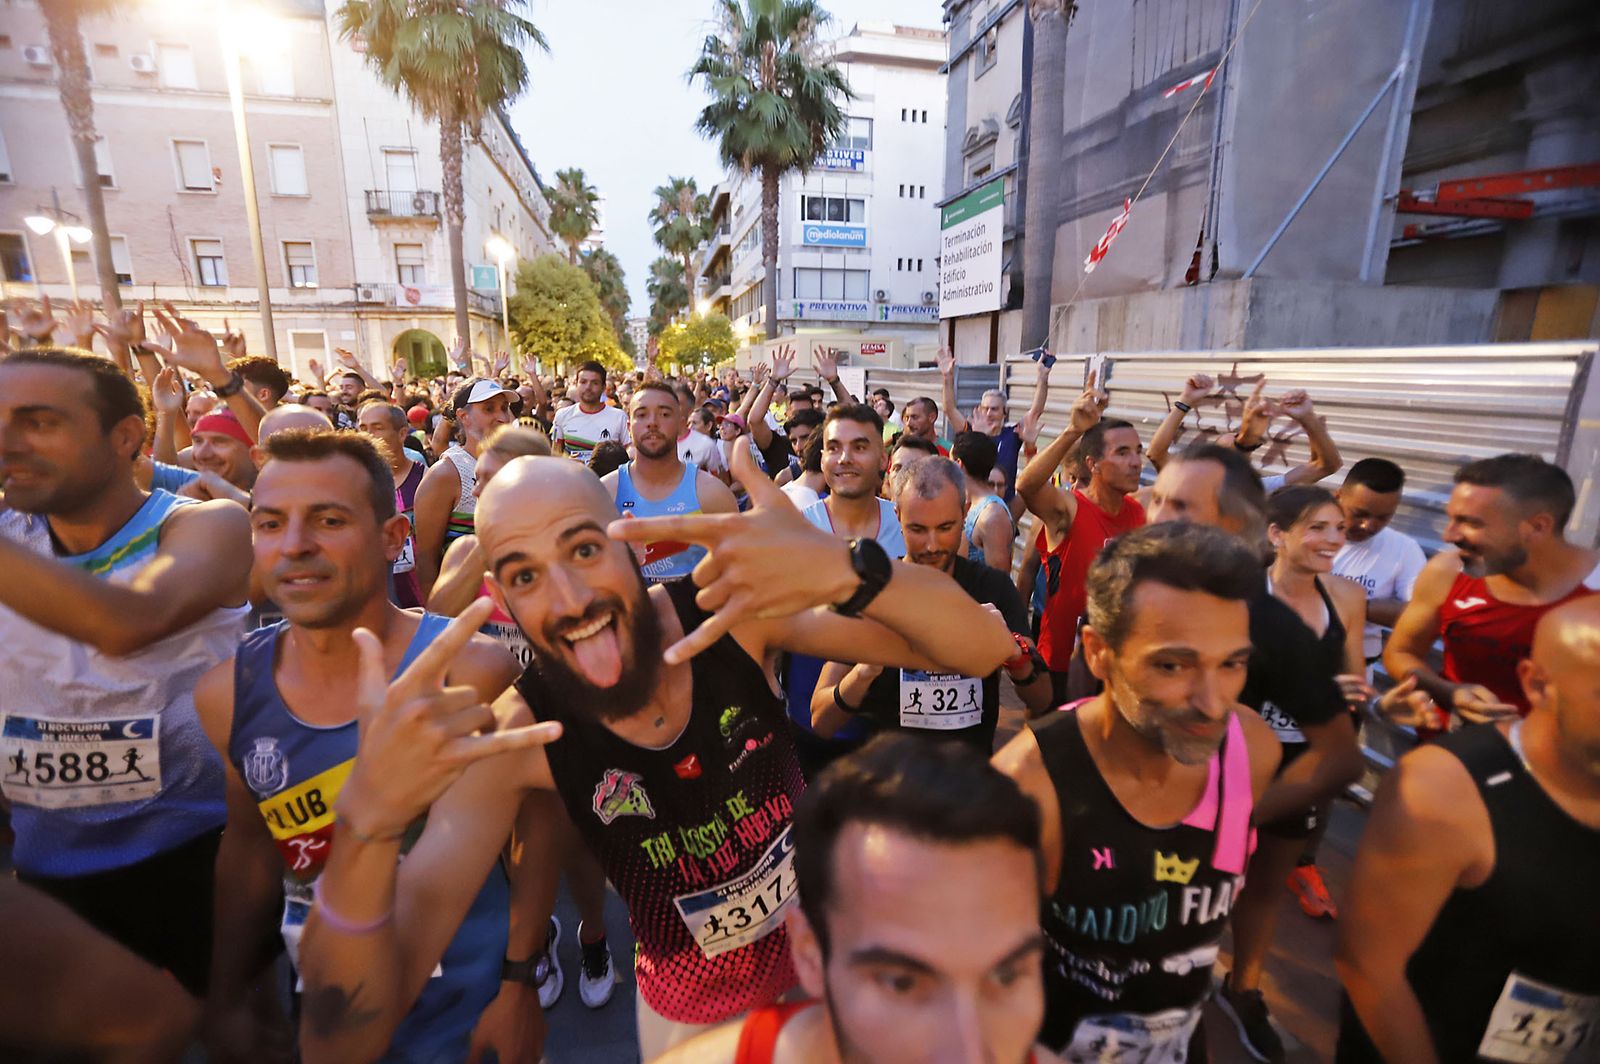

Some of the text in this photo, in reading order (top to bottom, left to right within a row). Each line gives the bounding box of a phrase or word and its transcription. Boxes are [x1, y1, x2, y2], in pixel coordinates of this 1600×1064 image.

[807, 229, 864, 242] mediolanum
[944, 223, 986, 249] Terminación
[943, 239, 993, 267] Rehabilitación
[943, 268, 967, 285] Edificio
[942, 281, 994, 302] Administrativo
[809, 303, 868, 311] PREVENTIVA
[891, 306, 940, 314] PREVENTIV
[932, 688, 959, 712] 32
[48, 722, 111, 732] NOCTURNA
[58, 733, 103, 742] HUELVA
[34, 751, 110, 784] 588
[728, 853, 776, 891] NOCTURNA
[727, 873, 782, 929] 317
